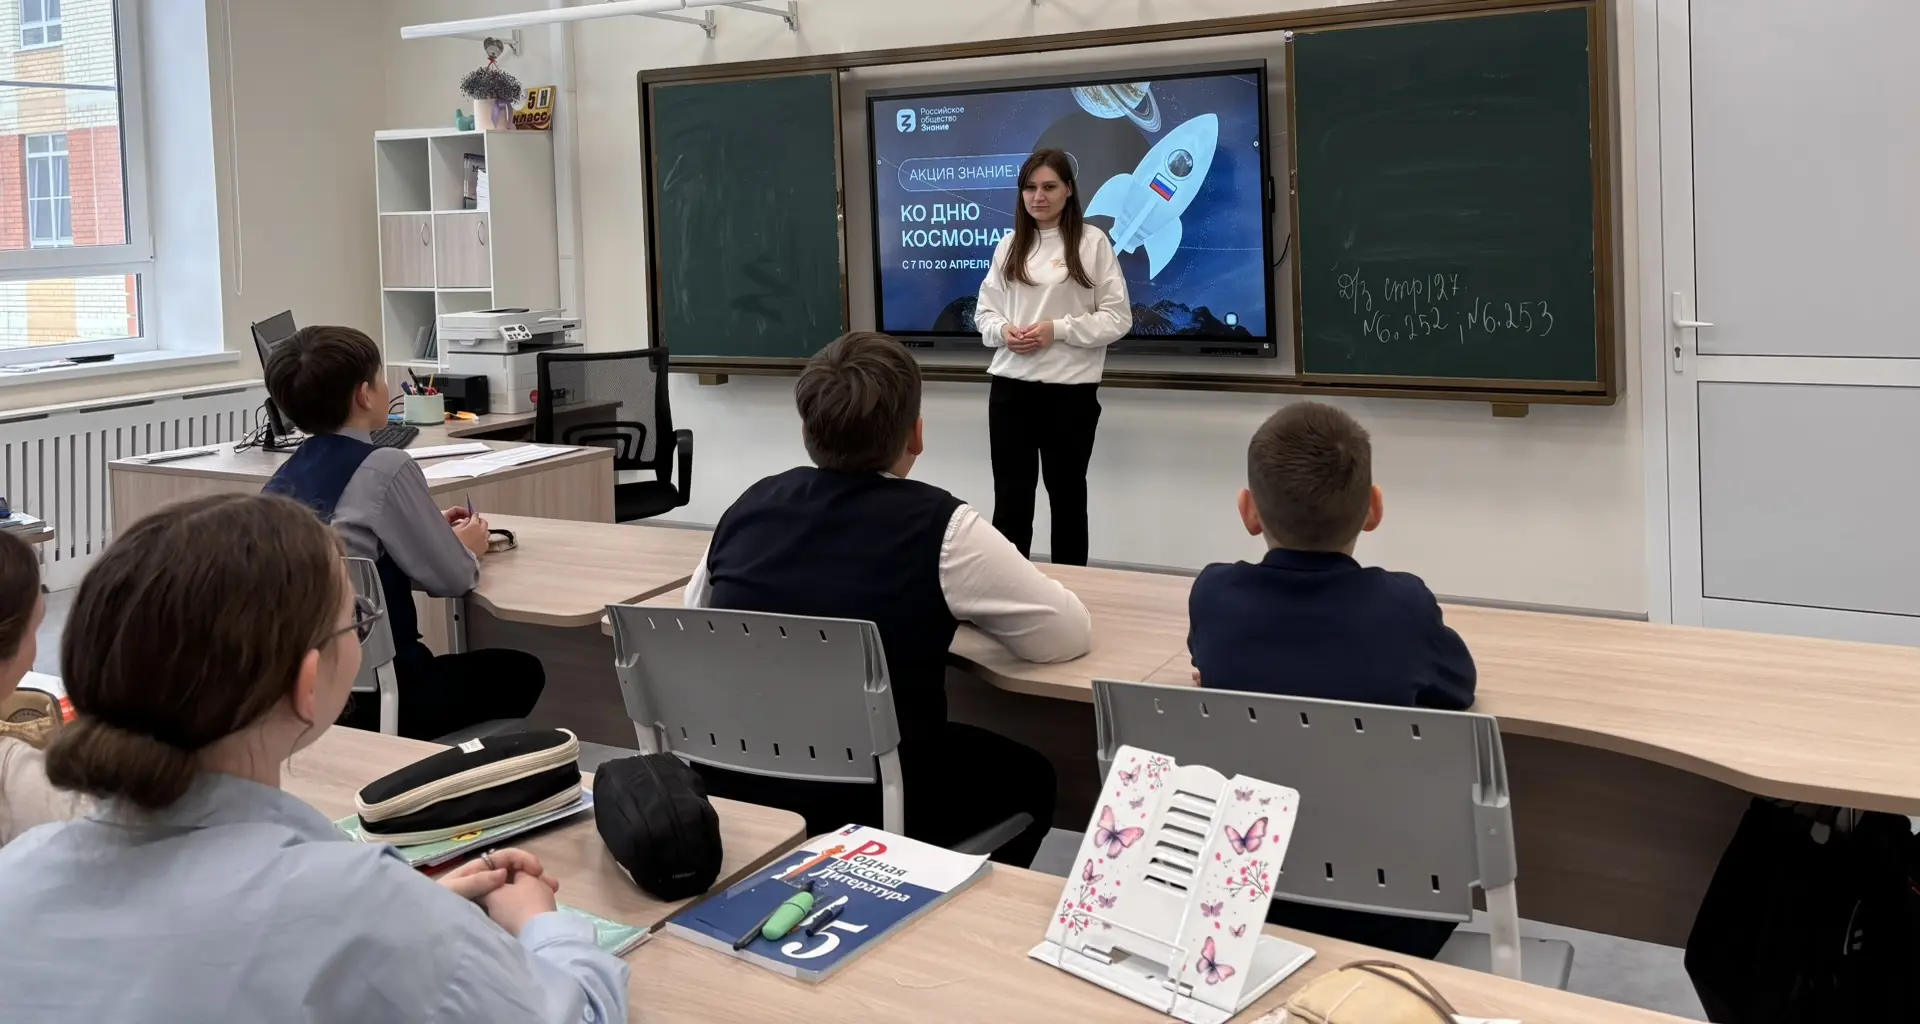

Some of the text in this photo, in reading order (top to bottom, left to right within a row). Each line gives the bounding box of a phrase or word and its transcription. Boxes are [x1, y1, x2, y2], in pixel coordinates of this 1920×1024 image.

[527, 91, 536, 109] 5
[920, 106, 965, 115] Российское
[920, 115, 957, 124] общество
[920, 123, 950, 132] Знание
[909, 167, 955, 182] АКЦИЯ
[900, 202, 980, 224] КО ДНЮ
[902, 259, 990, 270] С 7 ПО 20 АПРЕЛЯ
[840, 840, 908, 876] Родная
[808, 868, 911, 902] Литература
[781, 920, 869, 959] 5
